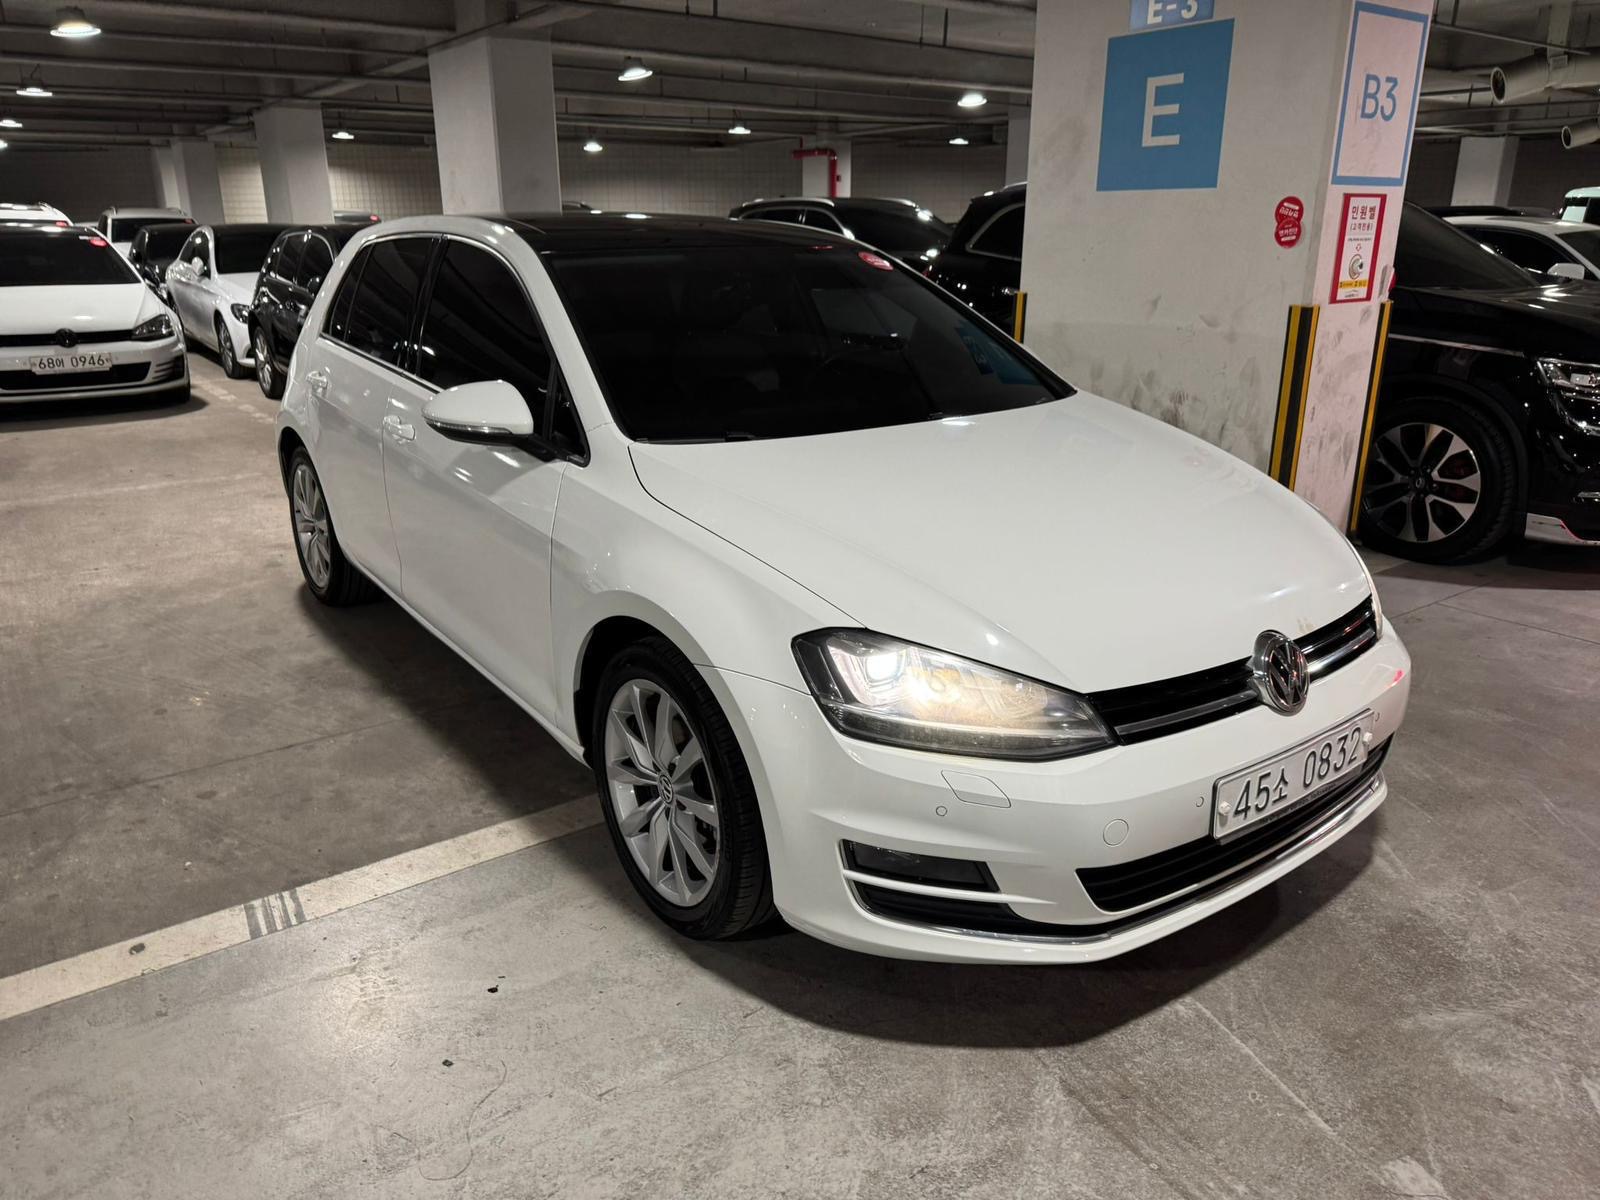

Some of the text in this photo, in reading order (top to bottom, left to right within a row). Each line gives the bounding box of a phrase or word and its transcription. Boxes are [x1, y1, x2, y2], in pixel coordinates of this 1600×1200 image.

[1142, 72, 1184, 147] E
[1360, 73, 1398, 121] B3
[71, 355, 105, 368] 0946
[1234, 767, 1288, 820] 45소
[1303, 727, 1361, 788] 0832
